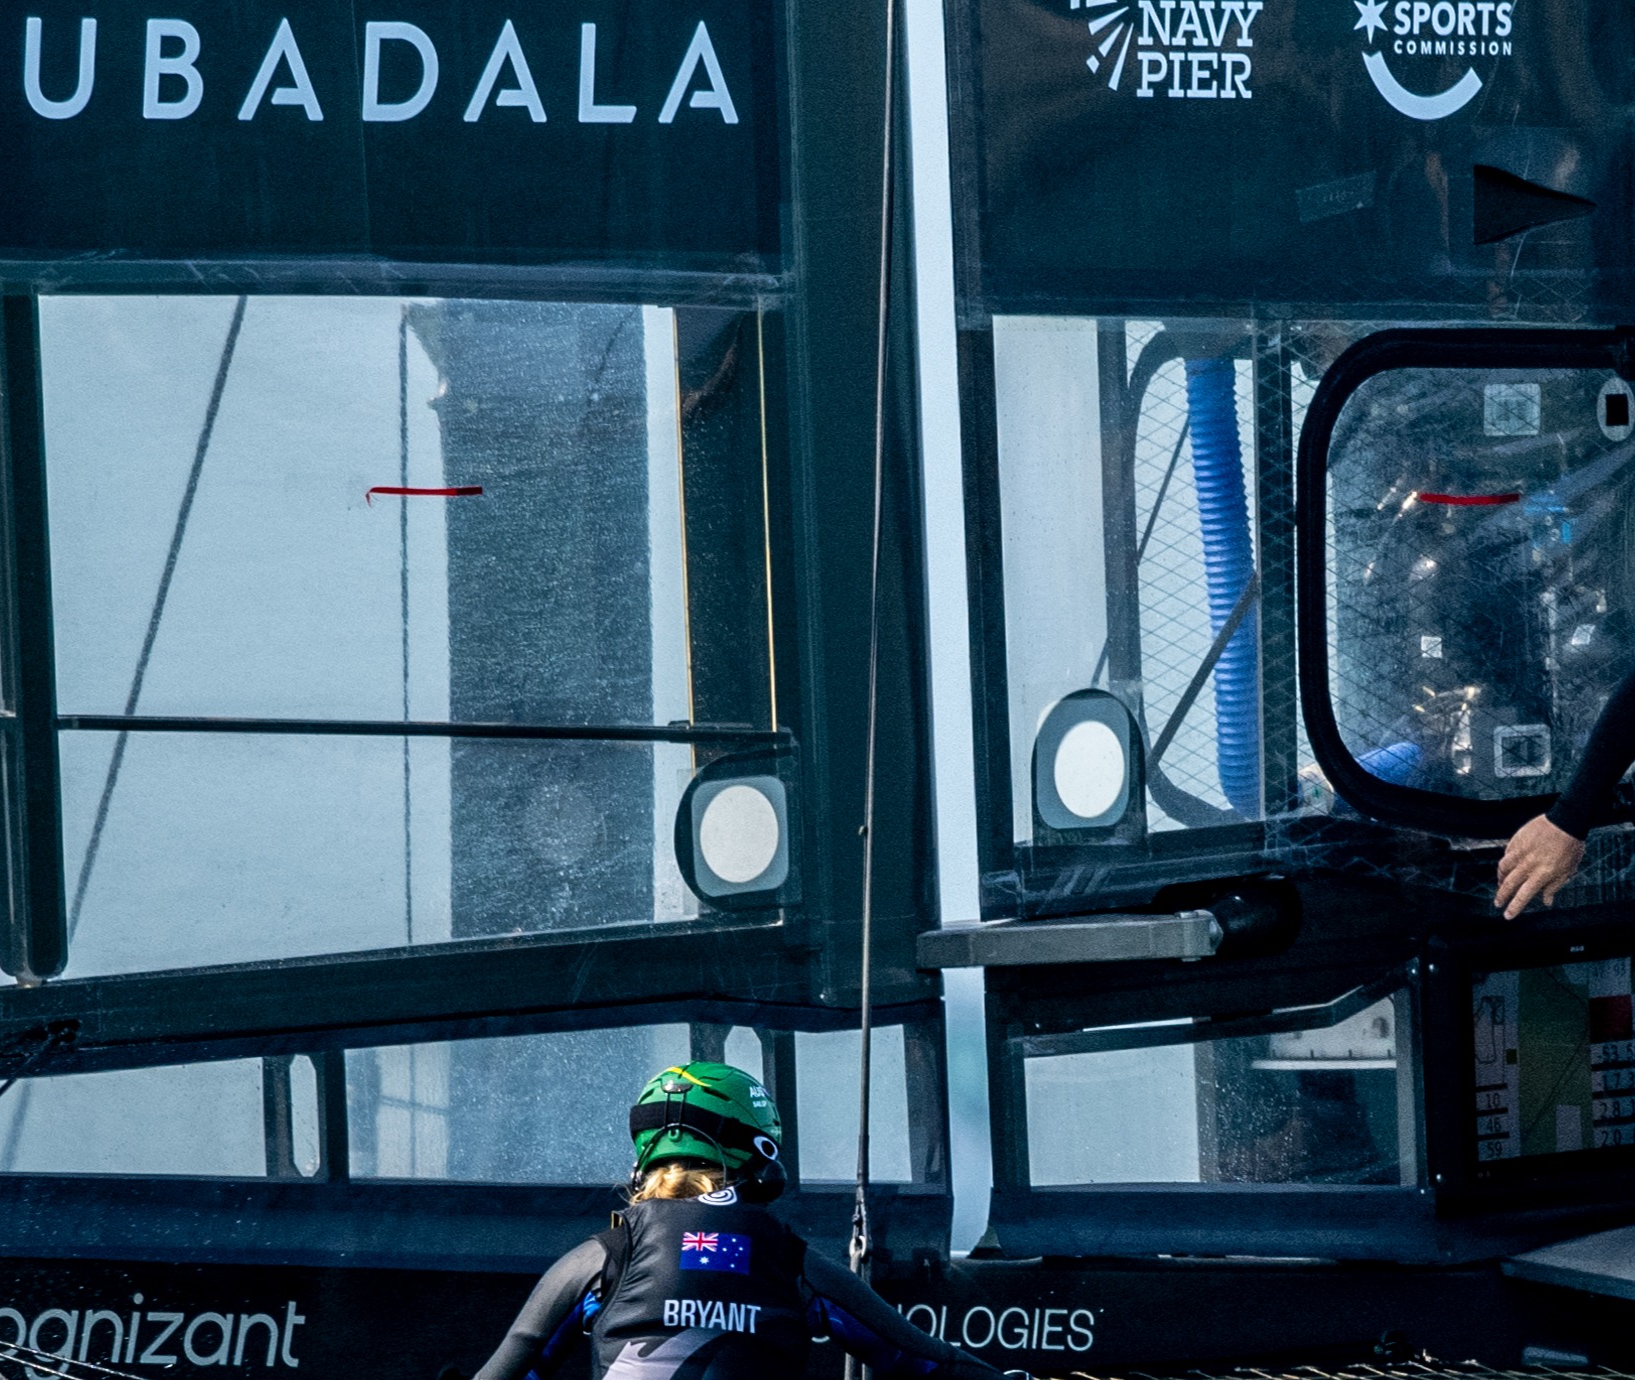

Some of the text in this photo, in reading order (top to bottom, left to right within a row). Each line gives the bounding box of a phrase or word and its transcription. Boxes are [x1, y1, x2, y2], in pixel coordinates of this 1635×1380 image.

[1137, 0, 1263, 47] NAVY
[1392, 1, 1513, 37] SPORTS
[1393, 40, 1513, 56] COMMISSION
[1136, 51, 1253, 98] PIER
[663, 1299, 762, 1335] BRYANT
